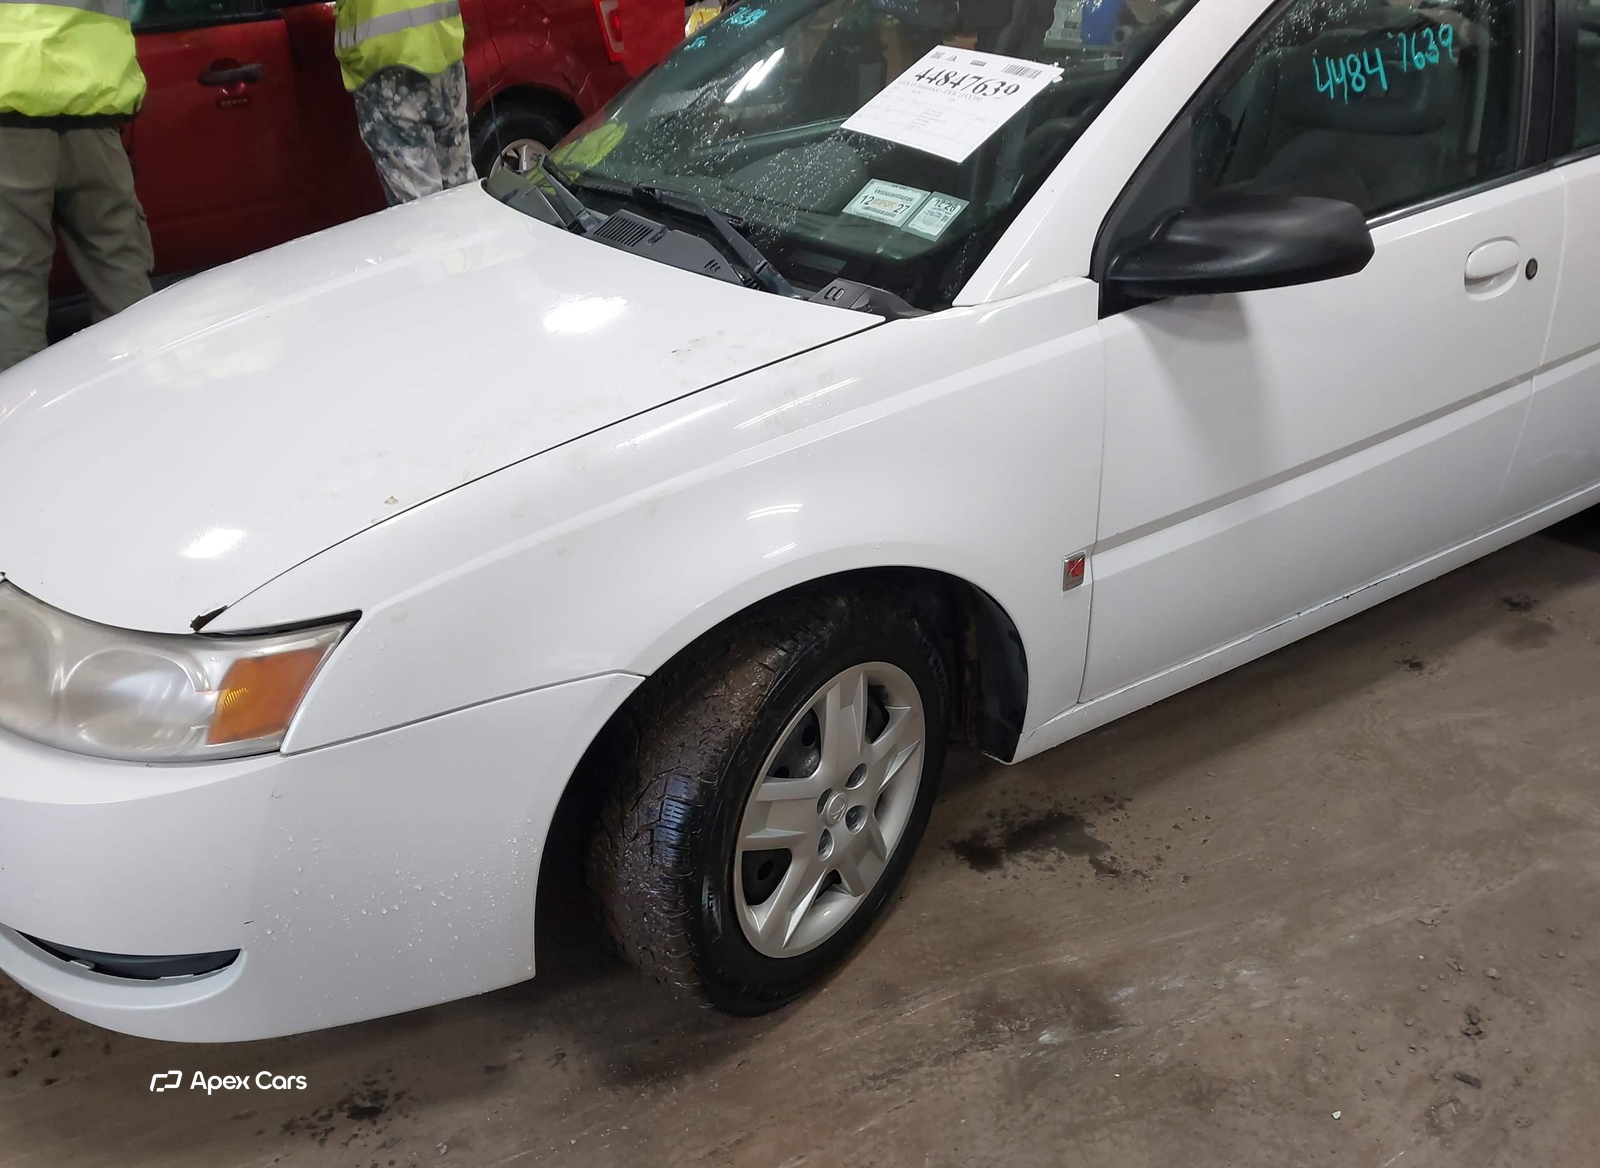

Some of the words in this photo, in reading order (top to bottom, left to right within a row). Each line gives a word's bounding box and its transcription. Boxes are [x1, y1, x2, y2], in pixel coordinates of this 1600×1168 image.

[914, 66, 1021, 99] 44847639
[1313, 48, 1389, 105] 4484
[860, 194, 875, 206] 12
[893, 203, 911, 216] 27
